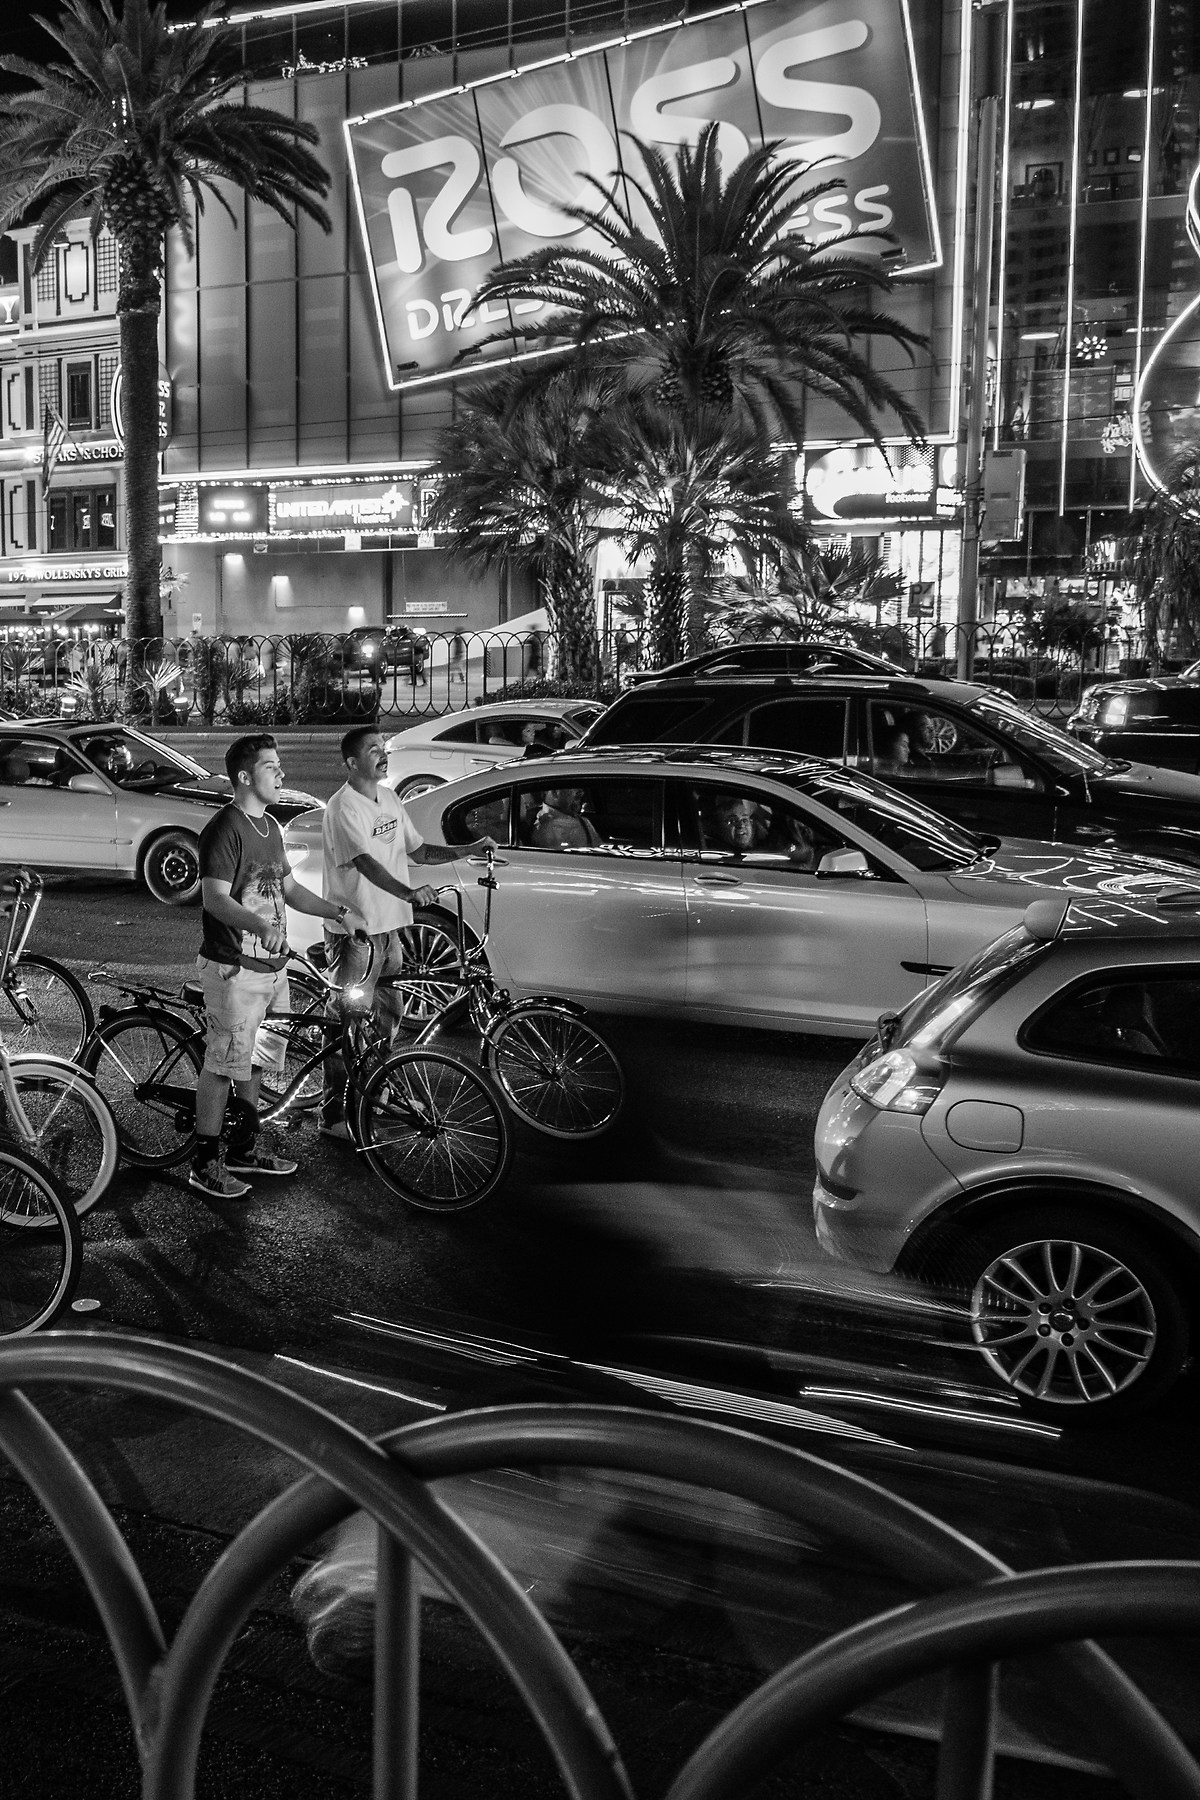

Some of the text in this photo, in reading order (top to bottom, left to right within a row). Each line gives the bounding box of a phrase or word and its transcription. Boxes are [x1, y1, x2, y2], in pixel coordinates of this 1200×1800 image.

[381, 19, 882, 274] ROSS
[33, 448, 77, 465] SAKS
[36, 567, 101, 581] WOLLENSKY'S
